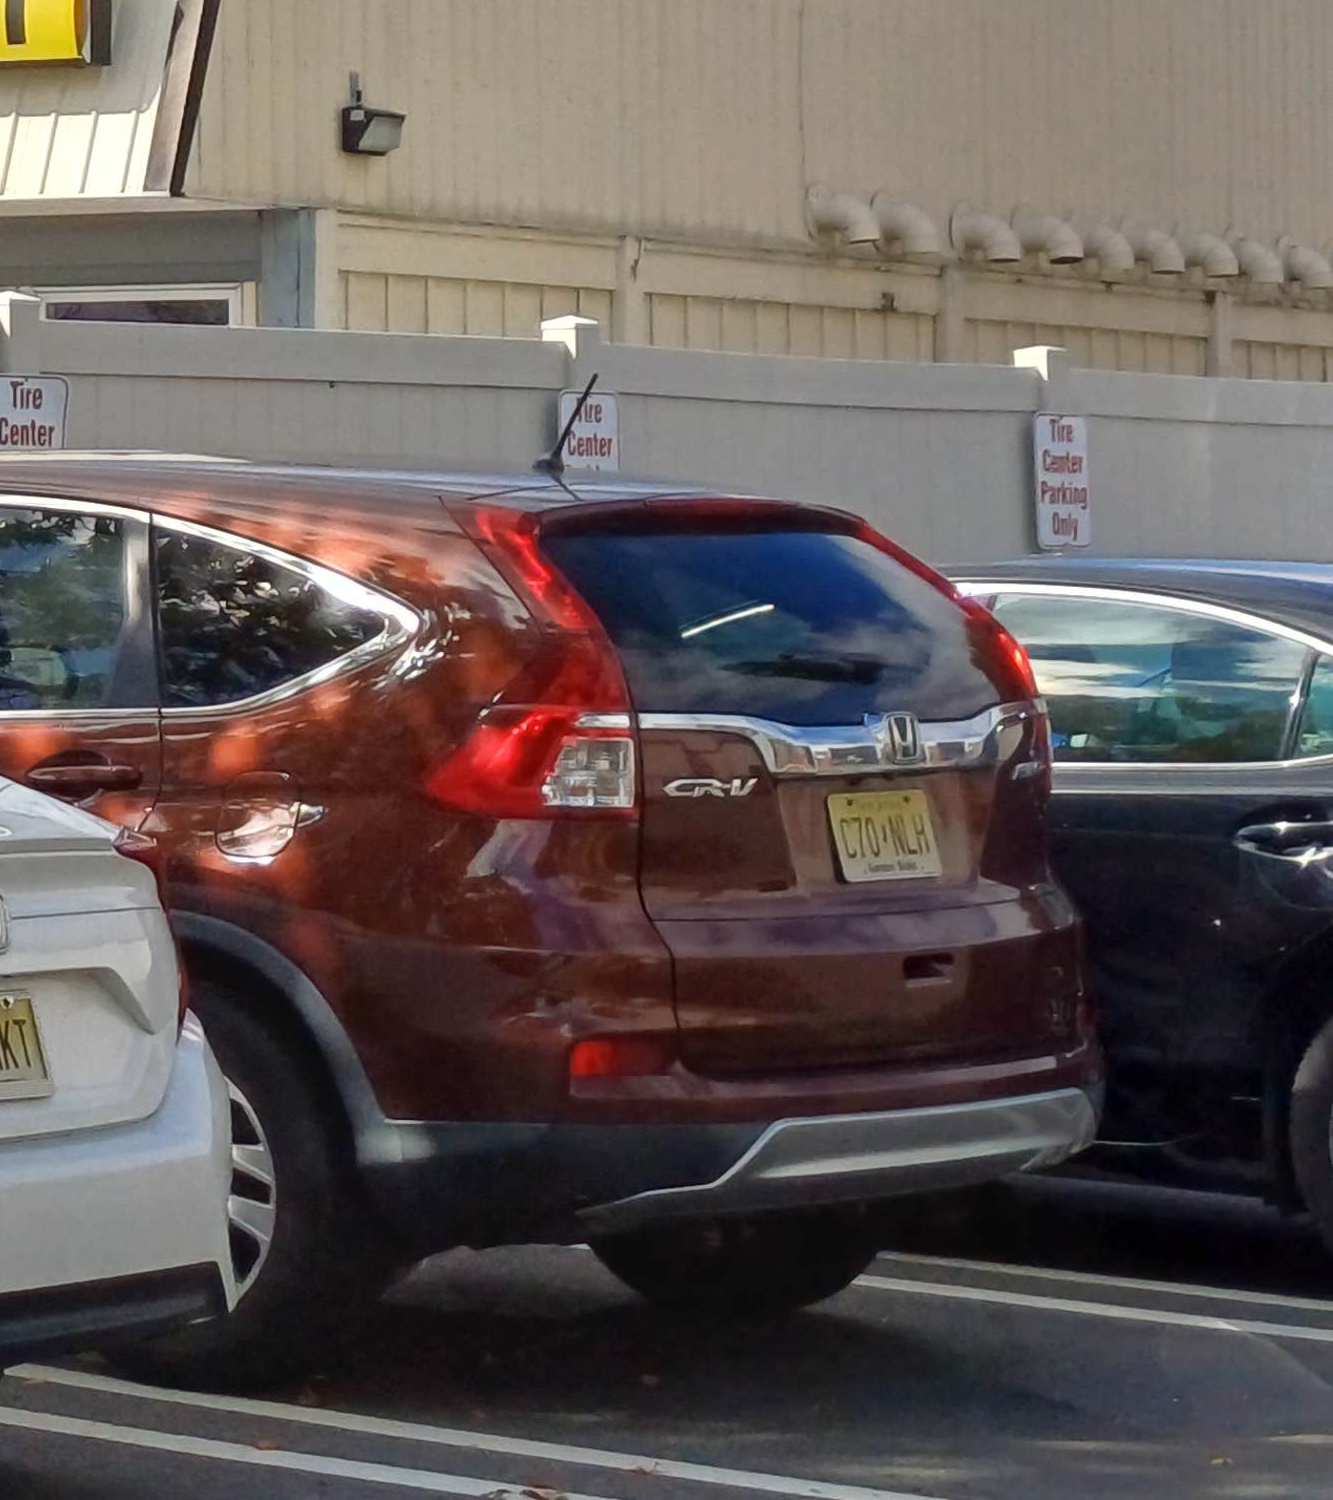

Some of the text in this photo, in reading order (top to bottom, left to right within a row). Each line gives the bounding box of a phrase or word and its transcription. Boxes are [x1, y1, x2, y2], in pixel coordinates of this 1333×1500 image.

[10, 380, 43, 410] Tire
[567, 430, 613, 458] Center
[1049, 418, 1074, 443] Tire
[1041, 480, 1087, 510] Parking
[1052, 511, 1078, 541] Only
